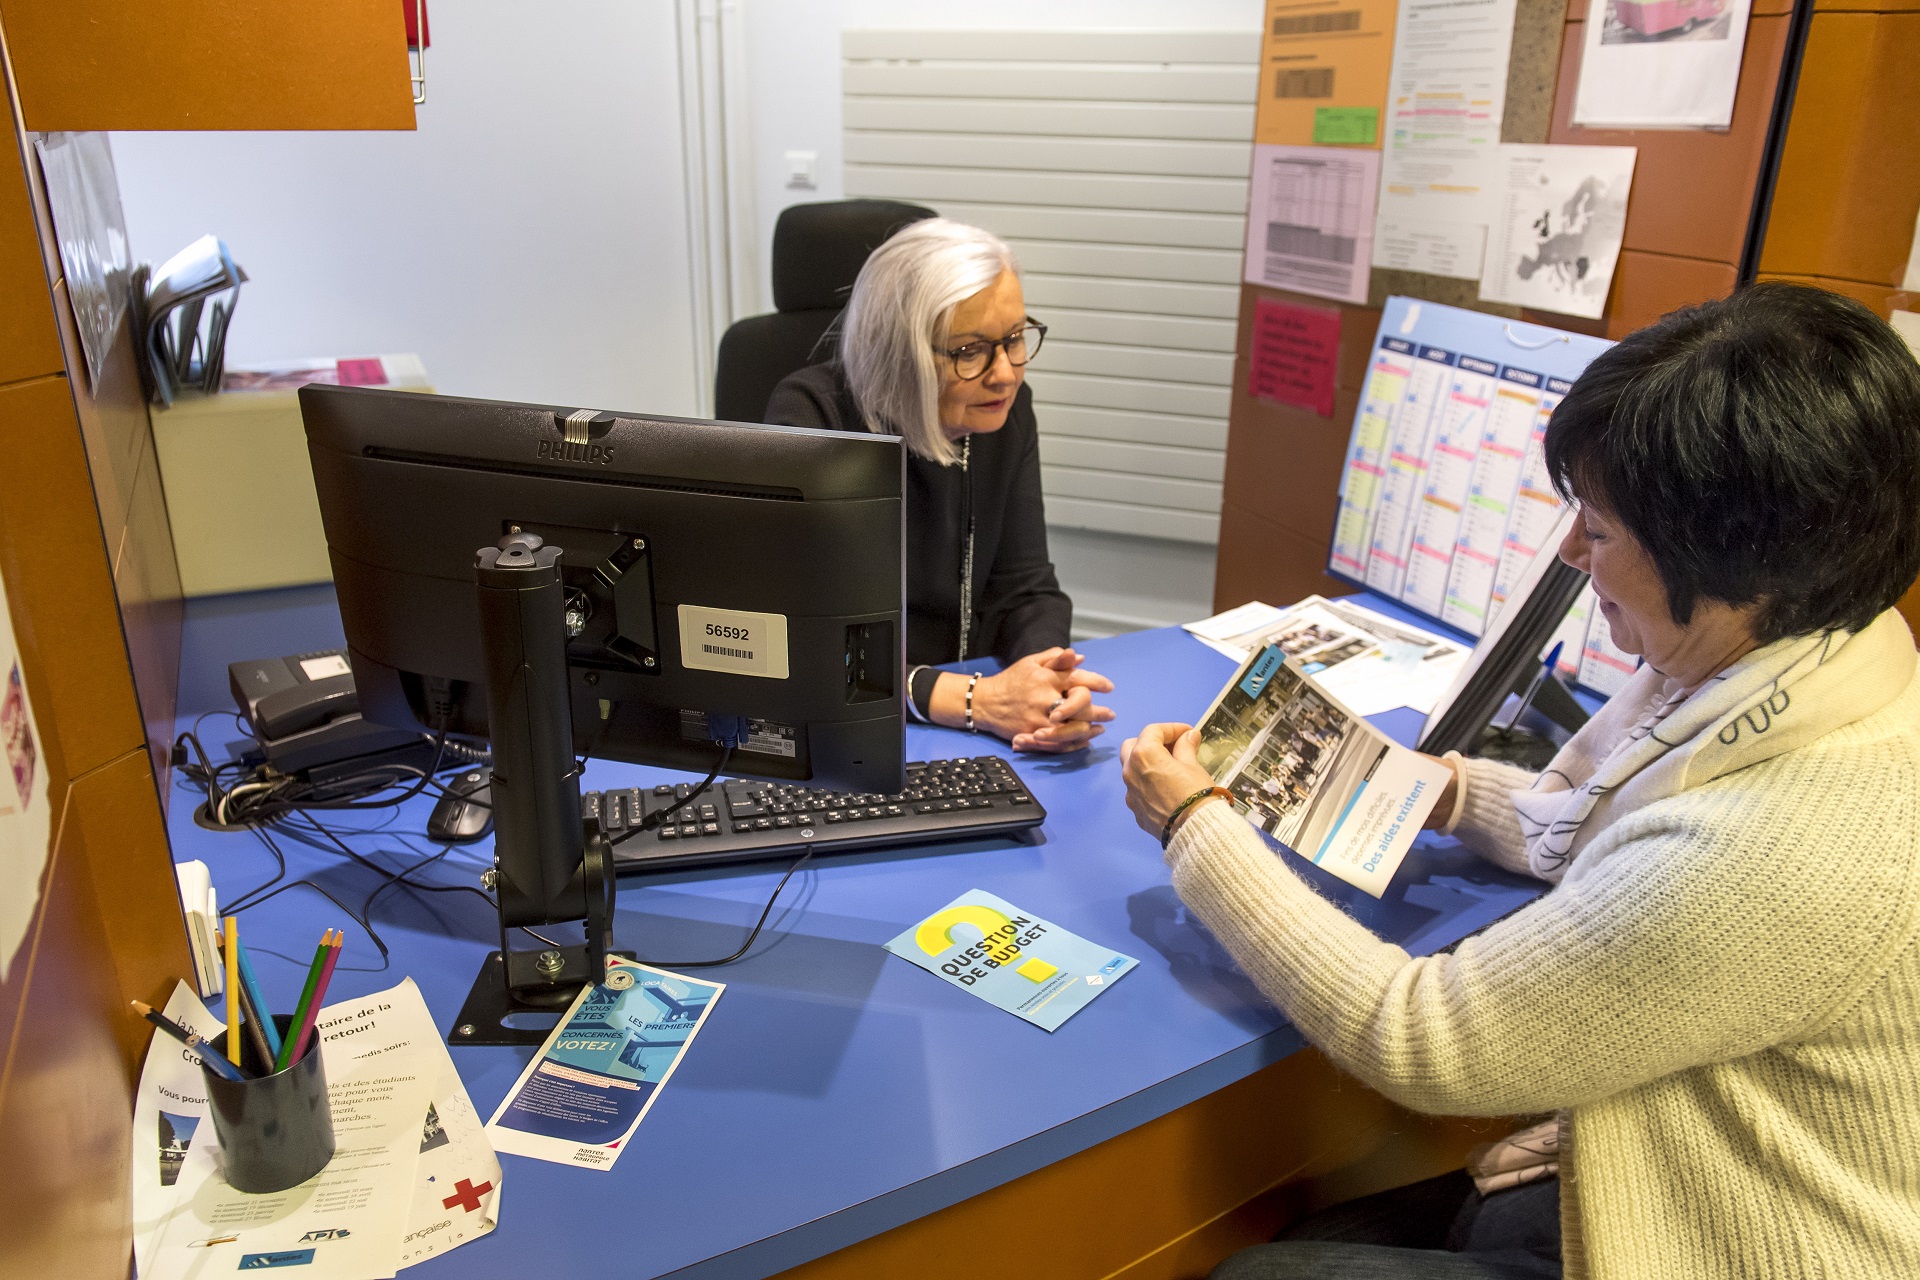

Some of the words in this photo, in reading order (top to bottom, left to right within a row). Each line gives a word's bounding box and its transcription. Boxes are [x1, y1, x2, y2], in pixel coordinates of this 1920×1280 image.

[536, 439, 615, 466] PHILIPS
[705, 623, 750, 641] 56592
[1362, 852, 1383, 874] Des
[1378, 824, 1401, 852] aides
[1396, 779, 1427, 823] existent
[940, 915, 1031, 977] QUESTION
[958, 967, 988, 987] DE
[982, 924, 1048, 970] BUDGET
[640, 980, 678, 997] LOCATAIRES
[318, 1015, 353, 1030] taire
[357, 1009, 375, 1018] de
[378, 1003, 392, 1012] la
[574, 1010, 606, 1021] ÊTES
[628, 1015, 644, 1028] LES
[644, 1022, 696, 1030] PREMIERS
[323, 1021, 376, 1042] retour!
[561, 1030, 624, 1039] CONCERNÉS,
[383, 1040, 411, 1053] soirs:
[372, 1075, 416, 1085] étudiants
[158, 1084, 180, 1100] Vous
[344, 1089, 369, 1098] pour
[329, 1098, 364, 1107] chaque
[403, 1218, 452, 1244] ançaise
